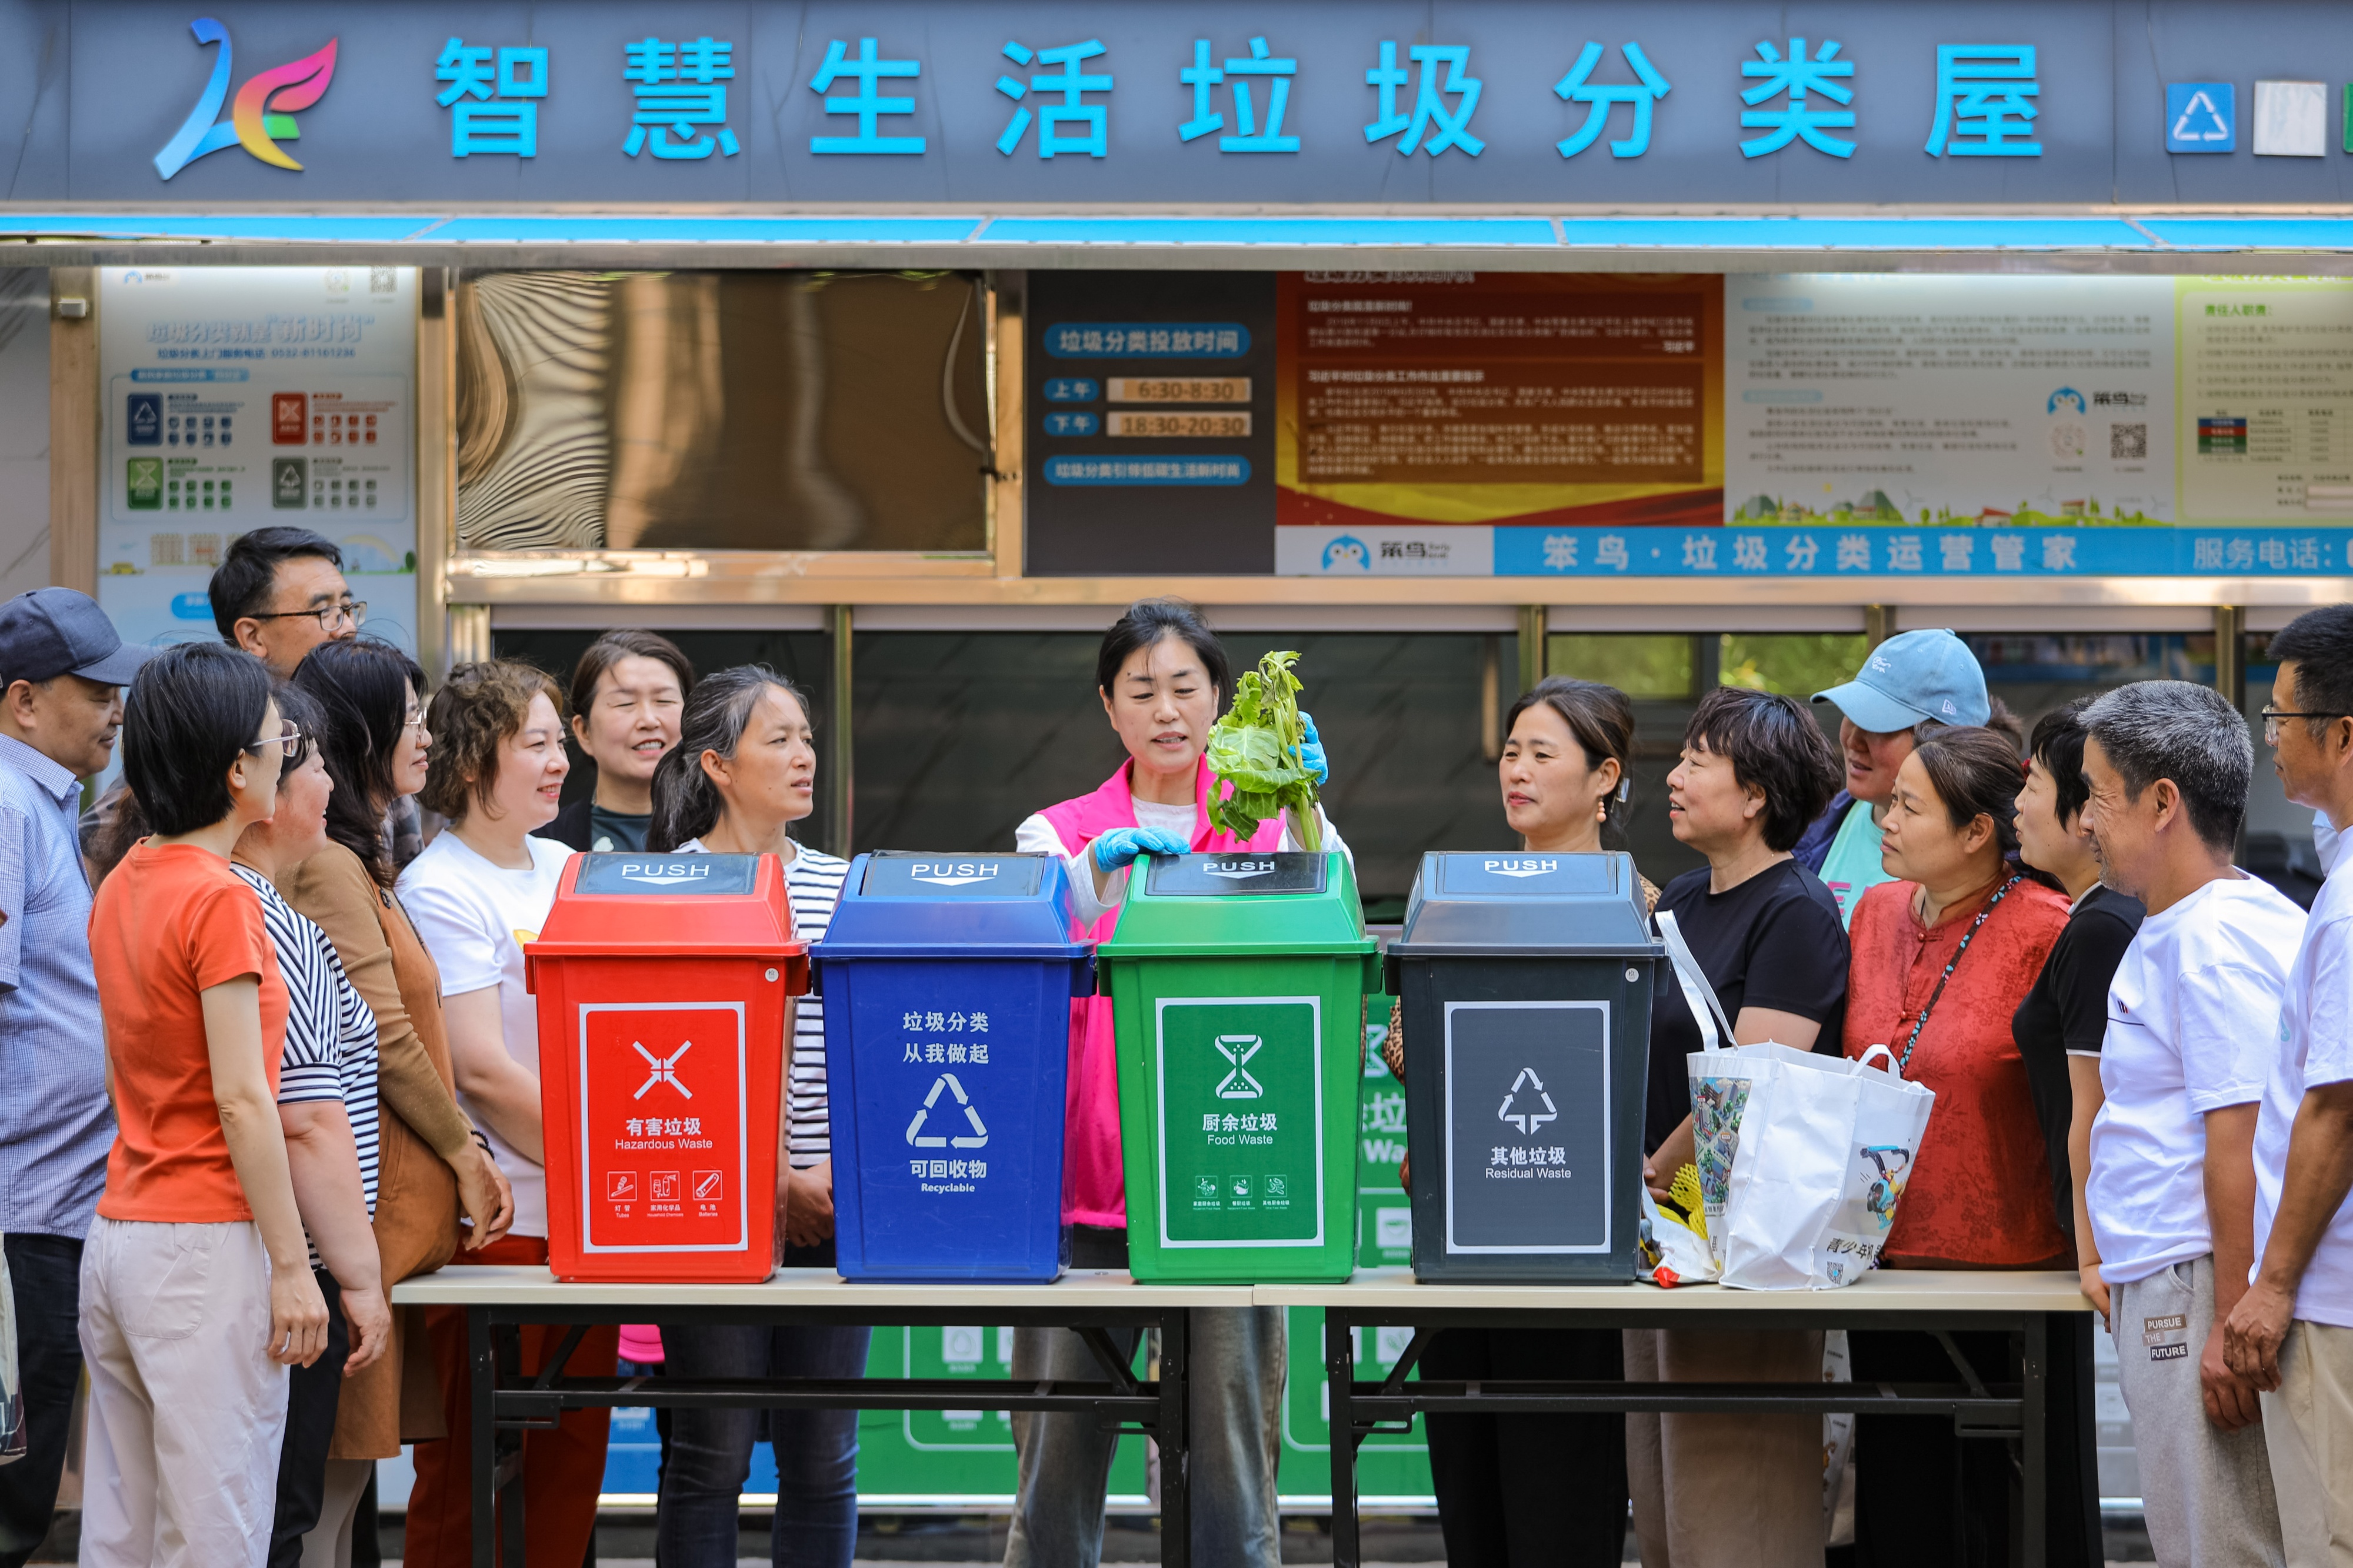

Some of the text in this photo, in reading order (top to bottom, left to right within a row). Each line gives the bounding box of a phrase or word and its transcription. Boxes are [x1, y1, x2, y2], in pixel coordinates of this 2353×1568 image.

[434, 36, 2042, 159] 智慧生活垃圾分类屋
[1060, 330, 1239, 353] 垃圾分类投放时间
[1053, 381, 1234, 398] 上午 6:30-8:30
[1053, 415, 1245, 434] 下午 18:30-20:30
[622, 863, 710, 877] PUSH
[911, 863, 999, 877] PUSH
[1203, 861, 1276, 872] PUSH
[1484, 859, 1558, 870] PUSH
[903, 1011, 989, 1033] 垃圾分类
[903, 1043, 989, 1065] 从我做起
[626, 1117, 702, 1136] 有害垃圾
[1202, 1113, 1278, 1132] 厨余垃圾
[615, 1139, 713, 1150] Hazardous Waste
[1208, 1135, 1273, 1145] Food Waste
[1491, 1146, 1566, 1166] 其他垃圾
[910, 1159, 987, 1179] 可回收物
[1485, 1168, 1571, 1179] Residual Waste
[921, 1183, 975, 1195] Recyclable
[2148, 1317, 2182, 1330] PURSUE
[2145, 1332, 2161, 1344] THE
[2151, 1345, 2186, 1359] FUTURE
